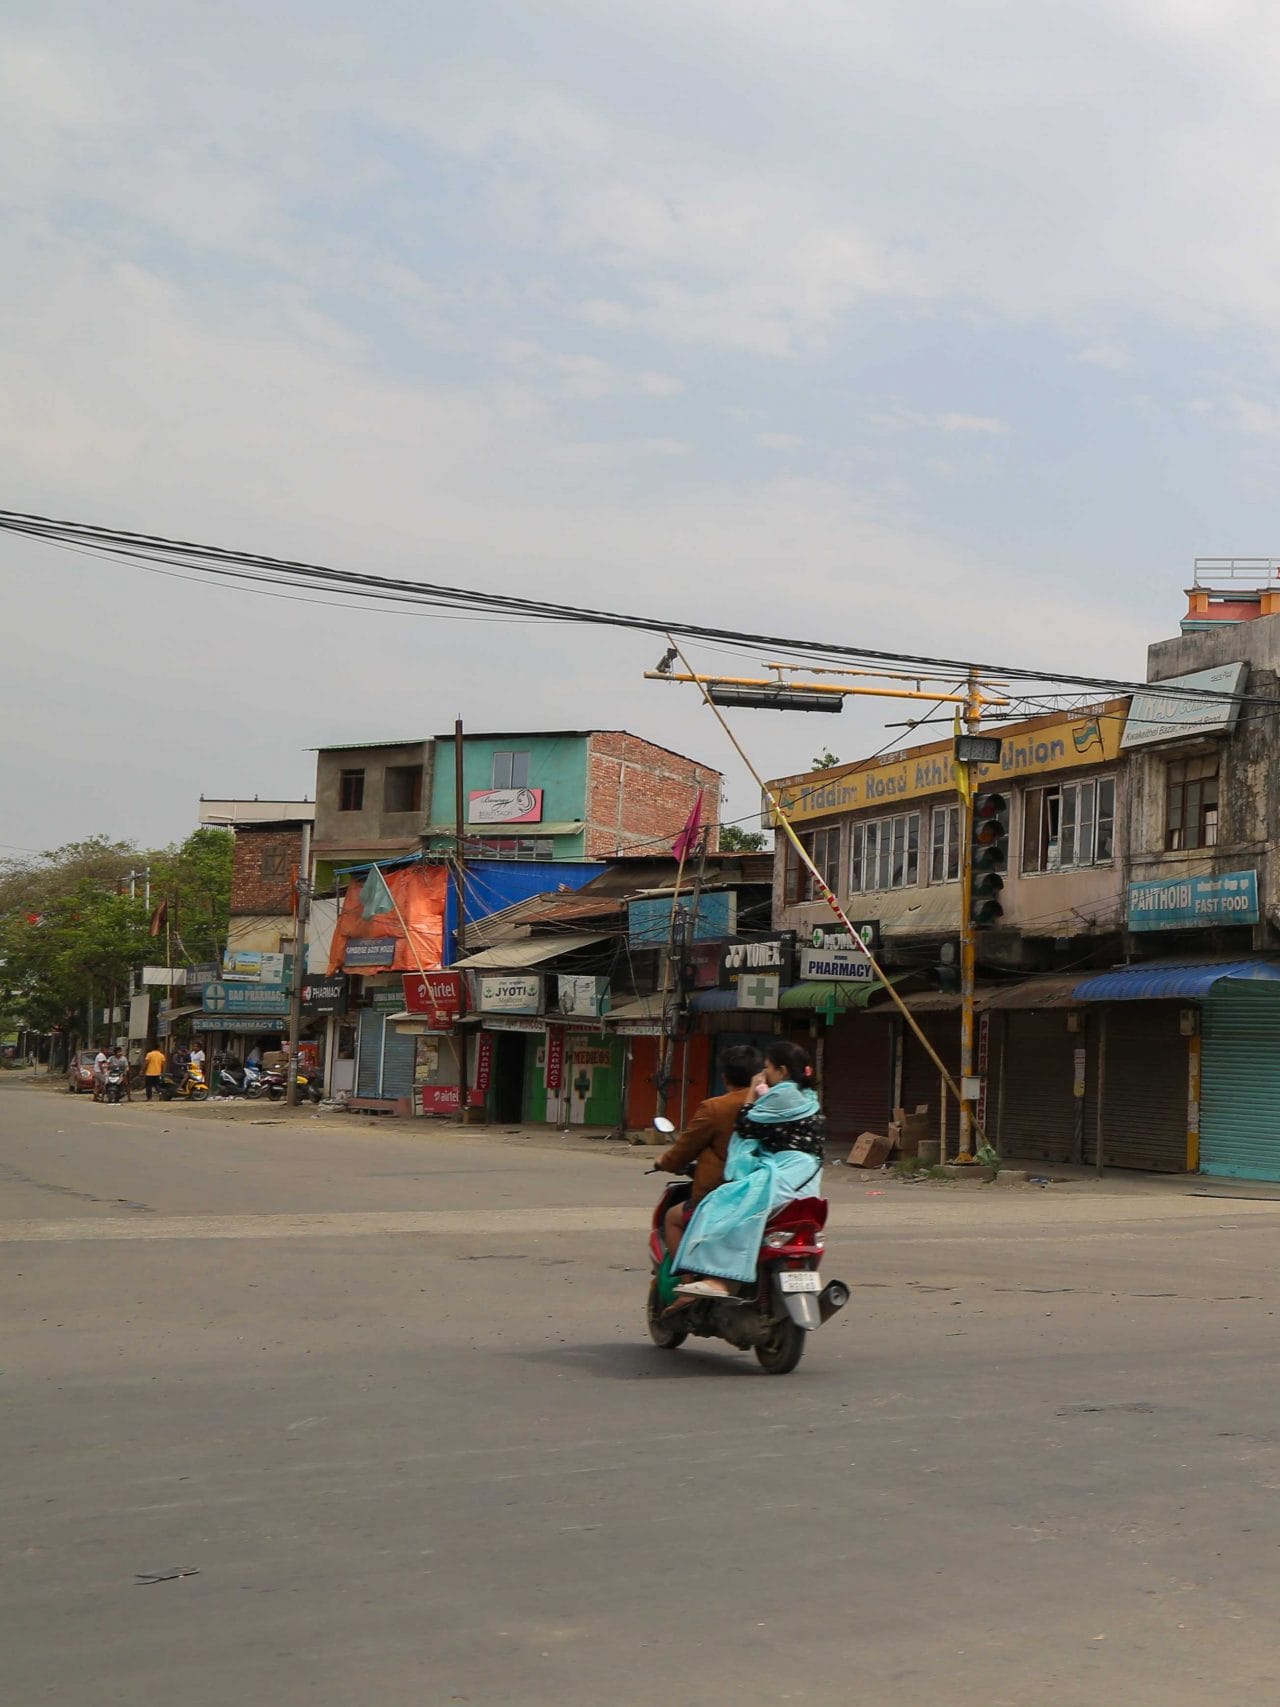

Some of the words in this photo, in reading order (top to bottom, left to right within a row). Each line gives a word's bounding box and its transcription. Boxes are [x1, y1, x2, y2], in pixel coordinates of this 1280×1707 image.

[865, 765, 908, 799] Road
[1001, 735, 1066, 771] Union
[1131, 884, 1192, 911] PANTHOIBI
[1195, 899, 1218, 913] FAST
[1221, 895, 1249, 911] FOOD
[808, 960, 872, 978] PHARMACY
[312, 986, 342, 999] PHARMACY
[495, 986, 527, 998] JYOTI
[223, 1021, 273, 1029] PHARMACY
[480, 1045, 490, 1089] PHARMACY
[550, 1040, 560, 1087] PHARMACY
[440, 1088, 459, 1102] airtel
